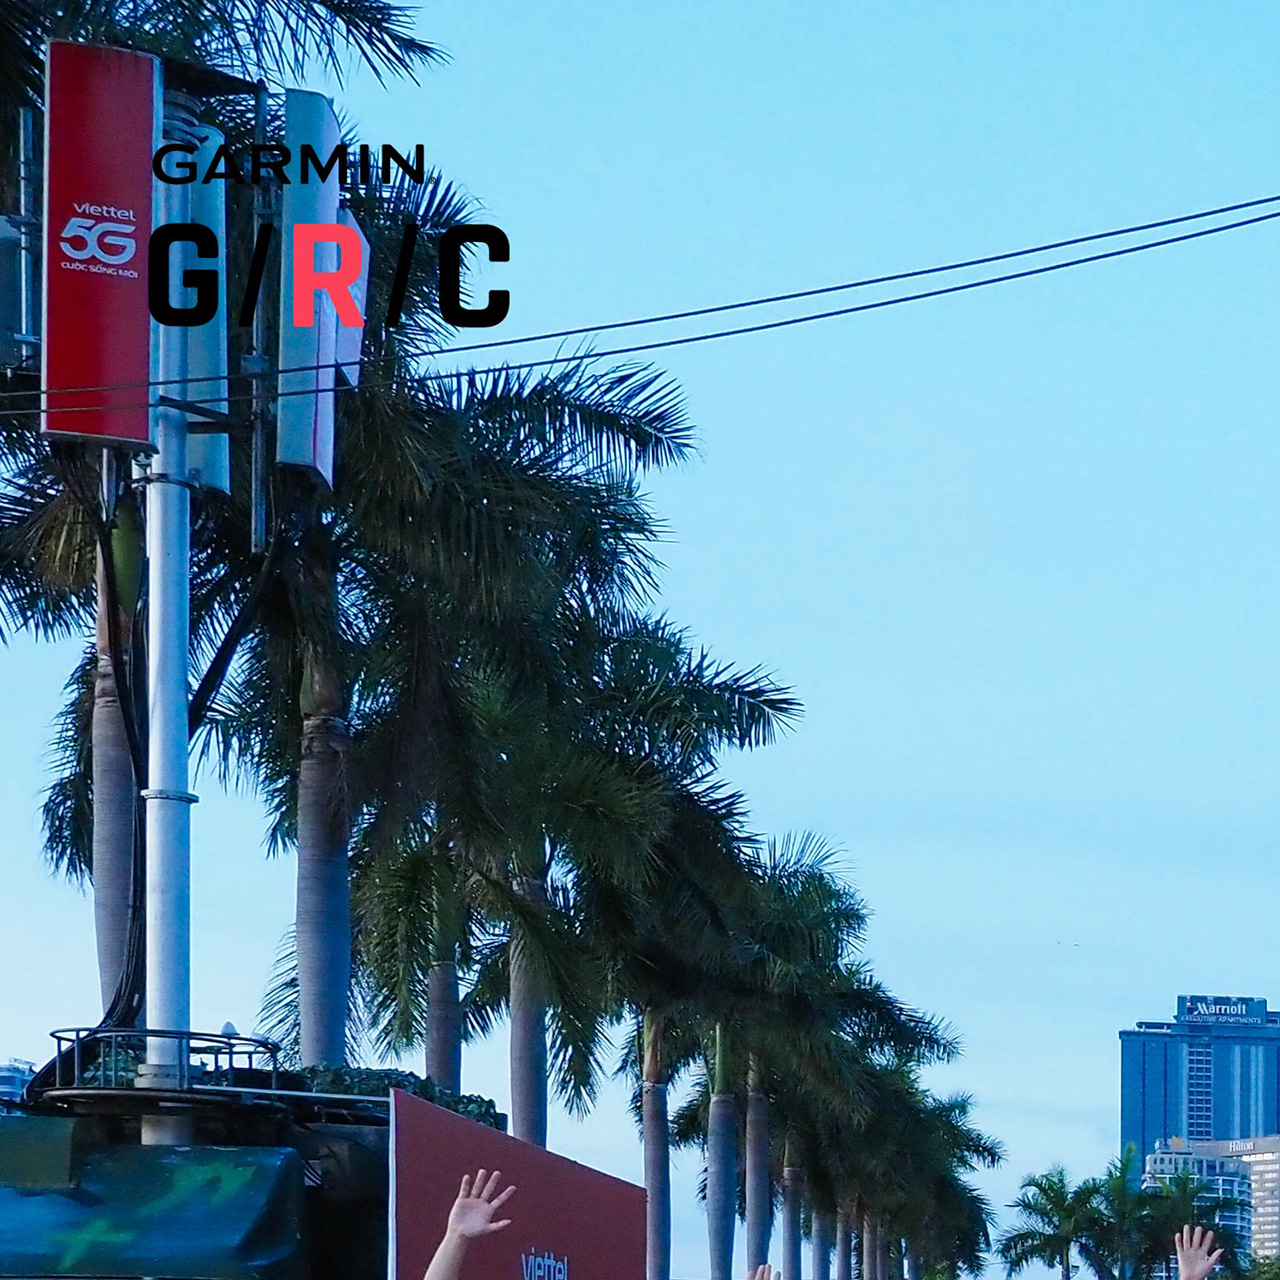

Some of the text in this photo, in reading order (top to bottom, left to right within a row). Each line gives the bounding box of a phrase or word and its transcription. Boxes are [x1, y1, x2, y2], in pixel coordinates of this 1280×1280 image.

[73, 203, 137, 221] viettel
[59, 217, 137, 265] 5G
[1229, 1141, 1255, 1152] Hilton
